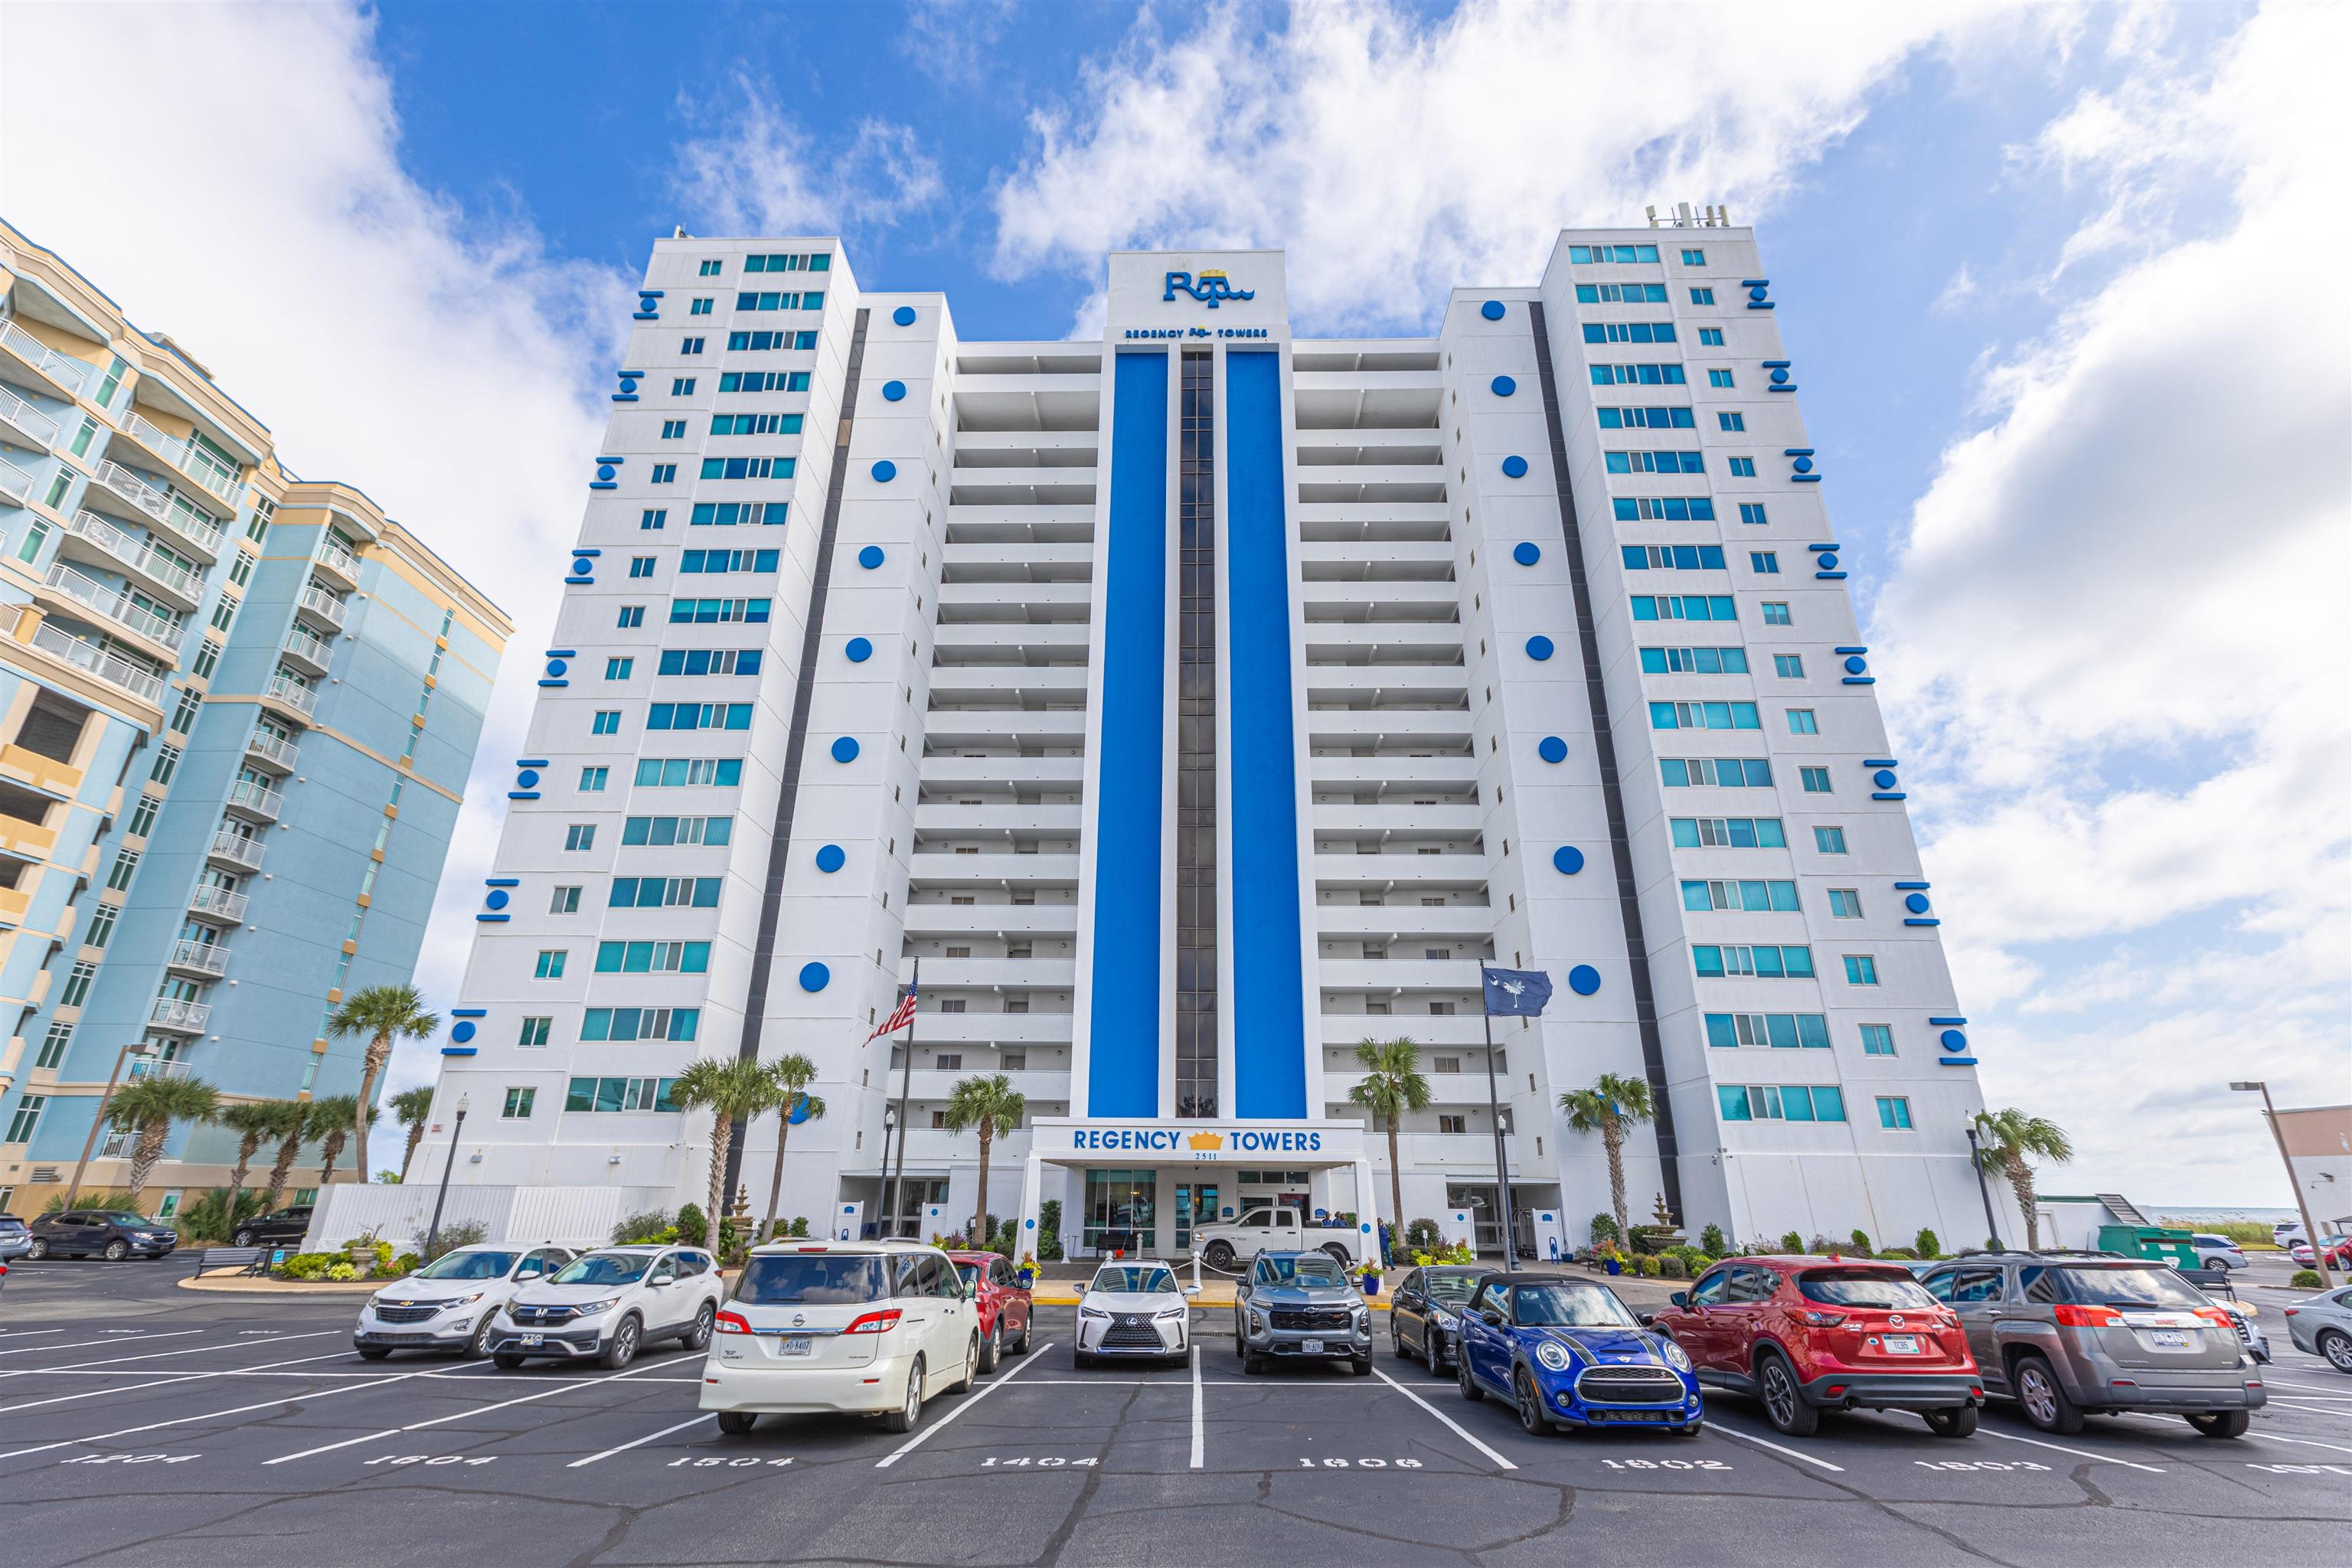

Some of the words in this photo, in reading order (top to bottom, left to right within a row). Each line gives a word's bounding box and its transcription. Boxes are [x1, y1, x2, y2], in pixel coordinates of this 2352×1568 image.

[1125, 329, 1184, 338] REGENCY
[1217, 328, 1268, 338] TOWERS
[1074, 1130, 1181, 1149] REGENCY
[1230, 1132, 1321, 1151] TOWERS
[60, 1454, 203, 1464] 1204
[363, 1455, 498, 1465] 1604
[667, 1457, 795, 1467] 1504
[981, 1457, 1099, 1466] 1404
[1299, 1458, 1423, 1468] 1606
[1601, 1459, 1734, 1470] 1802
[1913, 1461, 2053, 1471] 1803
